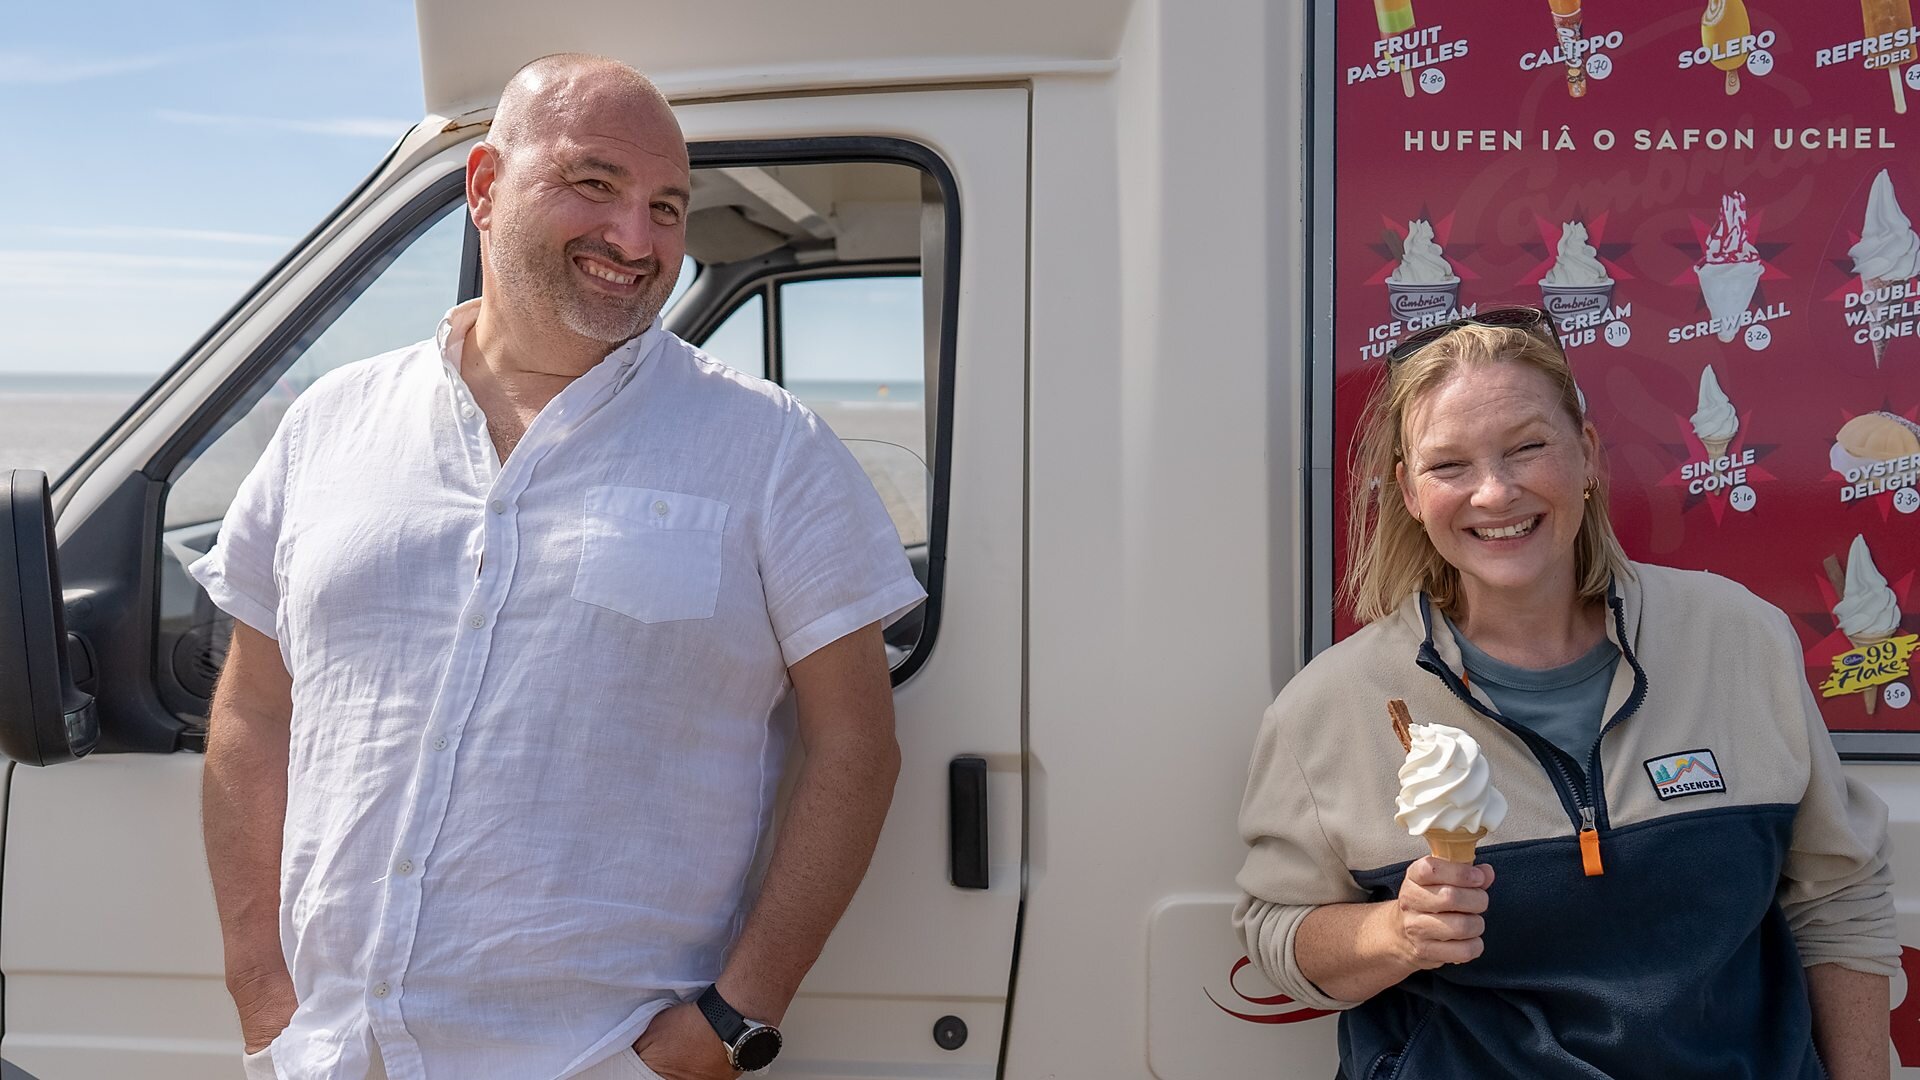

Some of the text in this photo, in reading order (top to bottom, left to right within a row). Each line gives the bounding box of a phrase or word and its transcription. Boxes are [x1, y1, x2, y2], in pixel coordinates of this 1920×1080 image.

[1374, 25, 1442, 58] FRUIT
[1519, 30, 1624, 71] CALIPPO
[1678, 30, 1776, 69] SOLERO
[1347, 39, 1469, 85] PASTILLES
[1863, 48, 1911, 70] CIDER
[1404, 124, 1896, 151] HUFEN IÂ O SAFON UCHEL
[1396, 294, 1447, 313] Cambrian
[1549, 296, 1600, 314] Cambrian
[1845, 281, 1920, 309] DOUBL
[1368, 302, 1477, 342] ICE CREAM
[1560, 302, 1631, 332] CREAM
[1668, 302, 1791, 343] SCREWBALL
[1559, 328, 1596, 350] TUB
[1854, 320, 1914, 344] CONE
[1681, 449, 1755, 480] SINGLE
[1845, 453, 1920, 483] OYSTER
[1689, 468, 1747, 495] CONE
[1840, 470, 1920, 502] DELIGH
[1866, 641, 1897, 664] 99
[1838, 660, 1900, 689] Flake
[1662, 780, 1721, 796] PASSENGER
